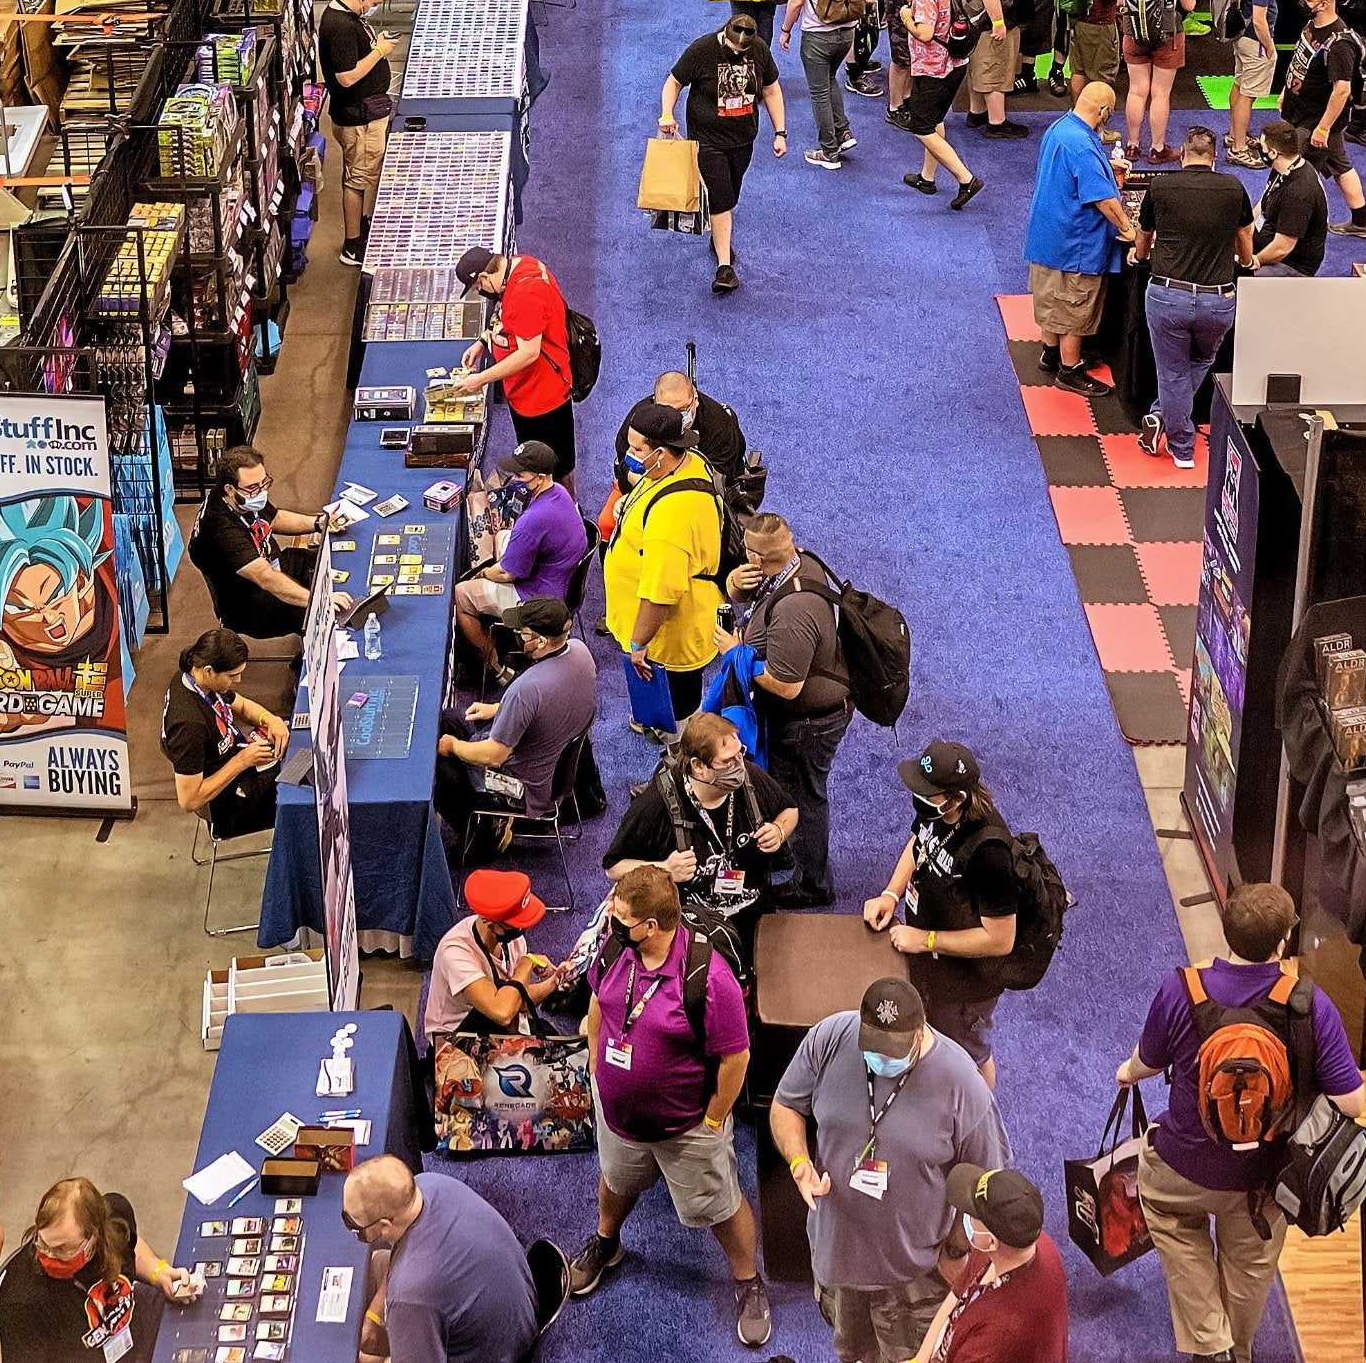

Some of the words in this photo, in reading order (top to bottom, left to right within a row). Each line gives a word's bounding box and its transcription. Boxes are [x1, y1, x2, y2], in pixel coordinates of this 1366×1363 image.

[26, 454, 40, 475] IN
[44, 455, 99, 478] STOCK.
[37, 693, 104, 721] GAME
[47, 748, 119, 772] ALWAYS
[48, 771, 122, 797] BUYING
